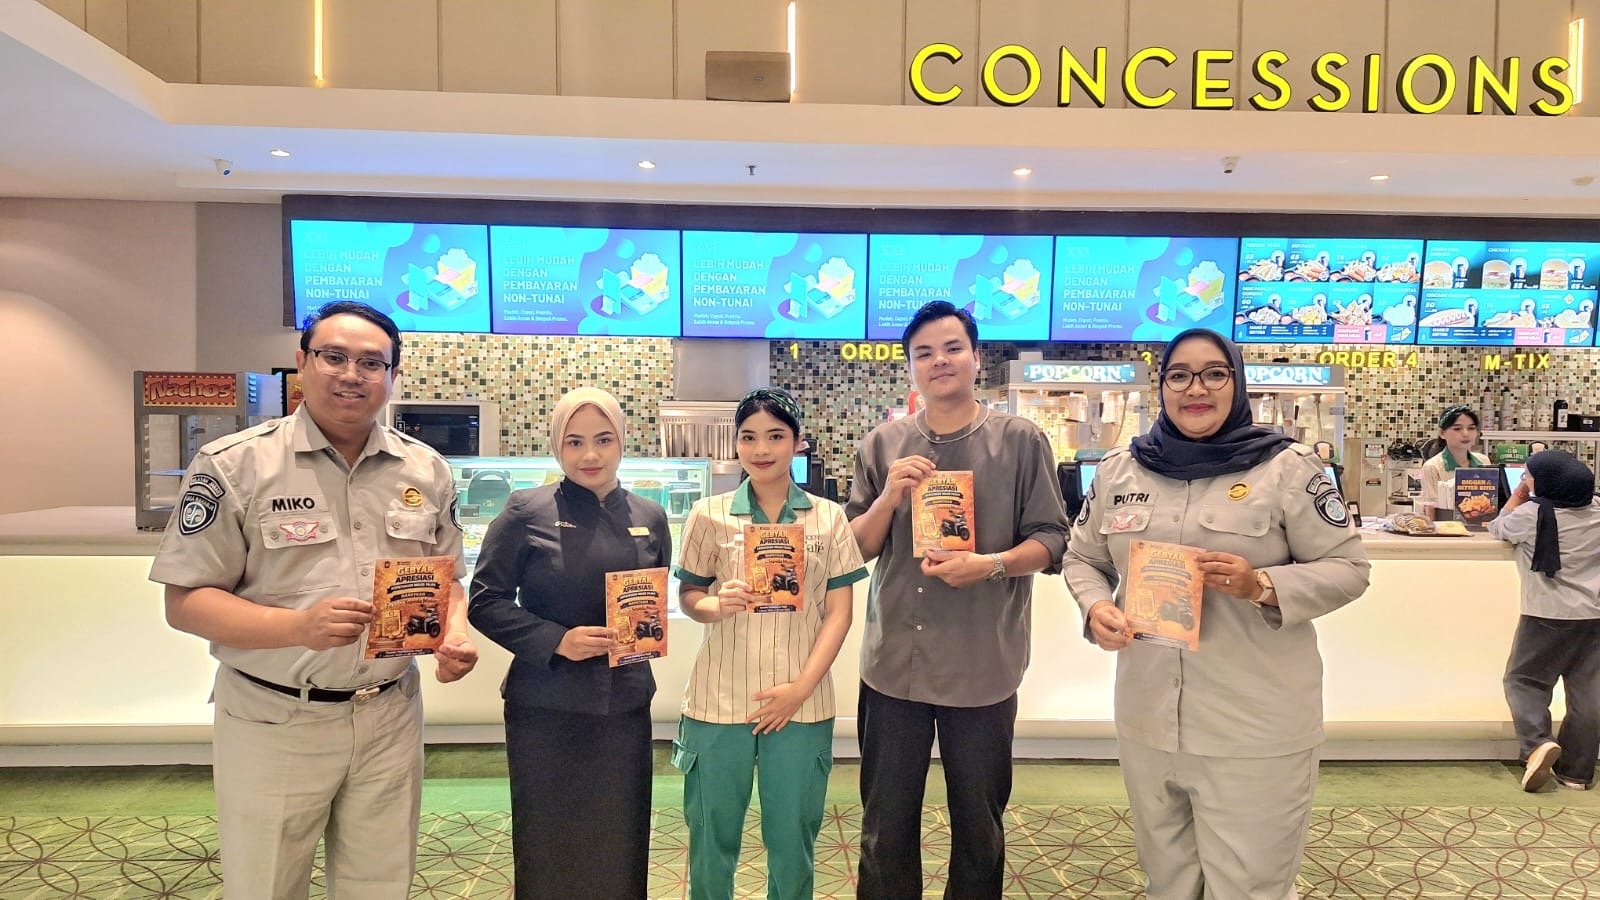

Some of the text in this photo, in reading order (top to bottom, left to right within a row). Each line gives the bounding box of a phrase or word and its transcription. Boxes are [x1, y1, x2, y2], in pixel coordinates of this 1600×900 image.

[909, 43, 1575, 115] CONCESSIONS
[339, 249, 378, 261] MUDAH
[537, 256, 575, 265] MUDAH
[304, 263, 352, 273] DENGAN
[727, 260, 764, 269] MUDAH
[1097, 263, 1134, 273] MUDAH
[503, 268, 548, 277] DENGAN
[694, 272, 737, 281] DENGAN
[305, 276, 383, 287] PEMBAYARAN
[503, 280, 578, 291] PEMBAYARAN
[879, 275, 922, 285] DENGAN
[1064, 277, 1107, 286] DENGAN
[306, 288, 370, 299] NON-TUNAI
[694, 285, 766, 295] PEMBAYARAN
[879, 288, 951, 297] PEMBAYARAN
[1063, 289, 1136, 299] PEMBAYARAN
[503, 293, 565, 304] NON-TUNAI
[694, 297, 753, 307] NON-TUNAI
[1063, 302, 1122, 312] NON-TUNAI
[790, 343, 799, 360] 1
[841, 343, 905, 361] ORDE
[1318, 351, 1418, 368] ORDER 4
[1484, 353, 1550, 370] M-TIX
[1029, 364, 1123, 381] POPCORN
[1244, 366, 1323, 383] OPCORN
[150, 379, 233, 402] Nachos
[271, 497, 315, 512] MIKO
[1113, 493, 1150, 506] PUTRI
[806, 541, 824, 553] afé
[397, 564, 434, 576] GEBYAR
[396, 575, 434, 583] APRESIASI
[623, 584, 654, 592] APRESIASI
